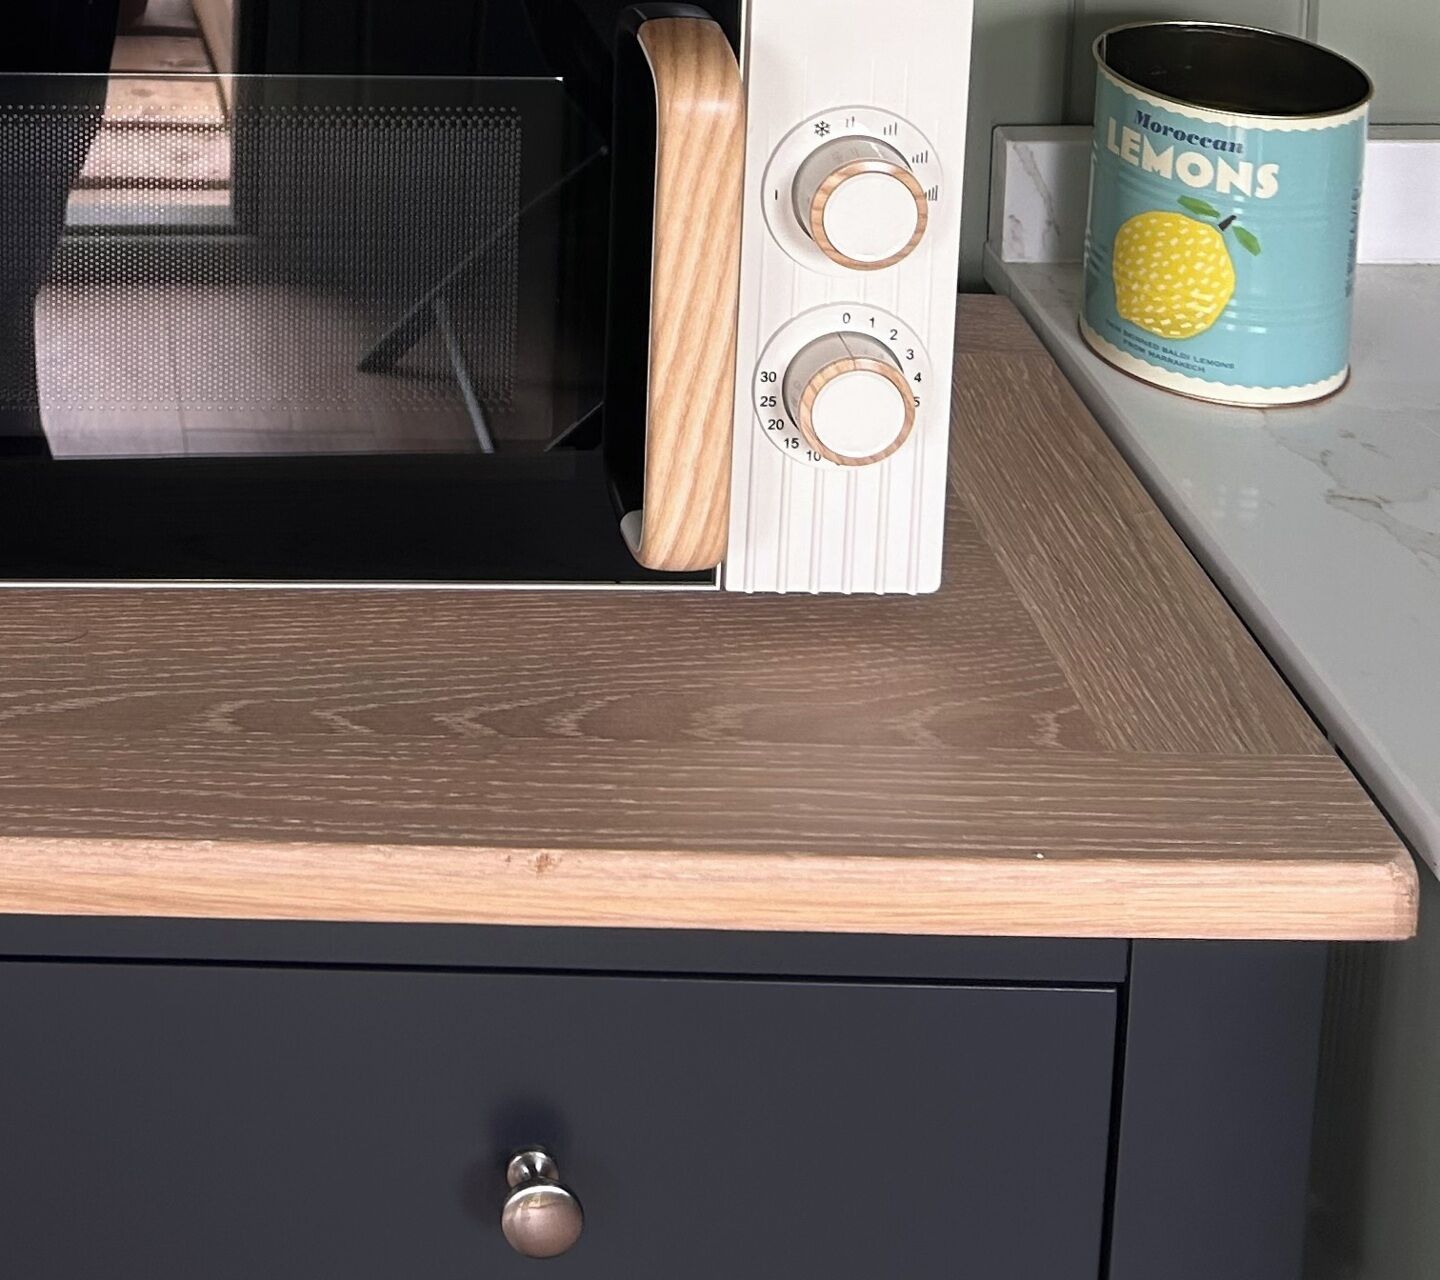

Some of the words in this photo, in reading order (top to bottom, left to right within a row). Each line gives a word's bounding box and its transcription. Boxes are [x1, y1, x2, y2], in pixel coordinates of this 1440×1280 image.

[1135, 109, 1245, 154] Moroccan
[1106, 117, 1280, 199] LEMONS
[842, 312, 851, 324] 0
[869, 317, 875, 328] 1
[890, 329, 898, 341] 2
[905, 349, 915, 361] 3
[1192, 355, 1236, 370] LEMONS
[760, 371, 777, 383] 30
[913, 372, 922, 383] 4
[759, 396, 777, 408] 25
[767, 419, 785, 431] 20
[783, 438, 800, 449] 15
[806, 451, 822, 462] 10
